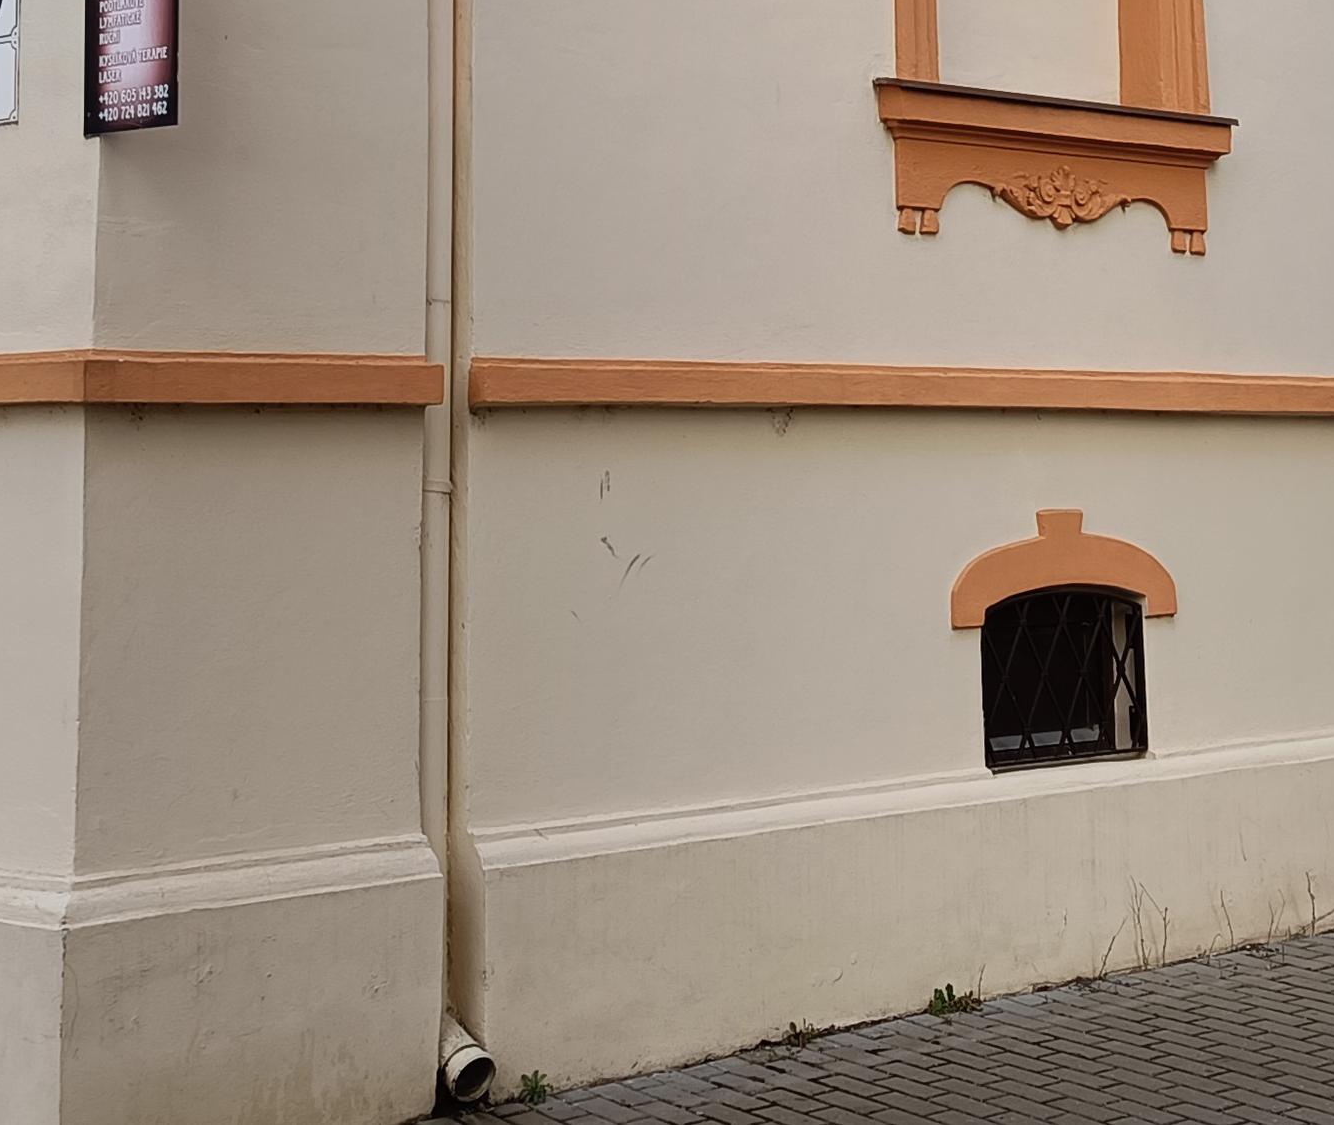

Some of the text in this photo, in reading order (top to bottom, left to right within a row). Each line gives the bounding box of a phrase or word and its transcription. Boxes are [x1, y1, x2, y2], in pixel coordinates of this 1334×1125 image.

[138, 46, 168, 62] TERAPIE
[98, 69, 121, 85] LASER
[98, 90, 118, 105] +420
[121, 88, 136, 103] 605
[153, 84, 169, 99] 382
[98, 100, 168, 122] +420 724 821 462
